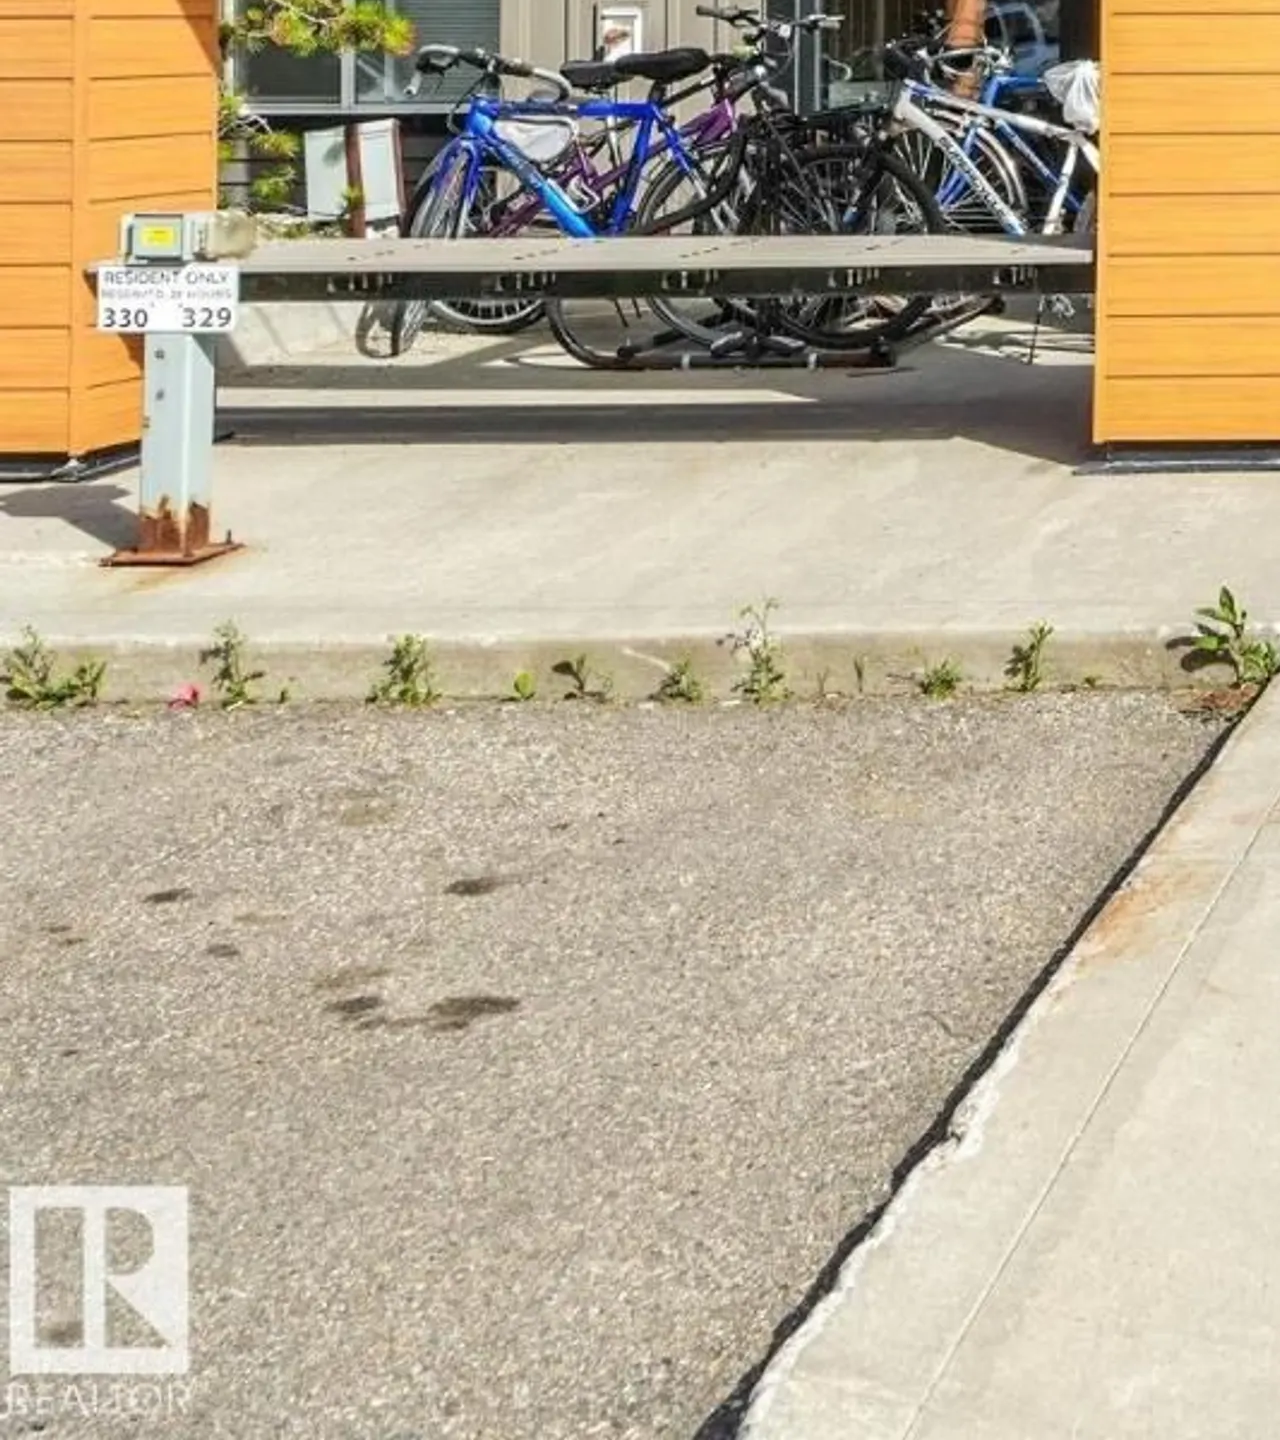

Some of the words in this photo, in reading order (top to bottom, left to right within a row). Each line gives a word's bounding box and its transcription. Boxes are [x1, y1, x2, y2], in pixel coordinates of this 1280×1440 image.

[104, 270, 180, 285] RESIDENT
[185, 270, 229, 285] ONLY
[103, 307, 148, 328] 330
[182, 307, 232, 328] 329
